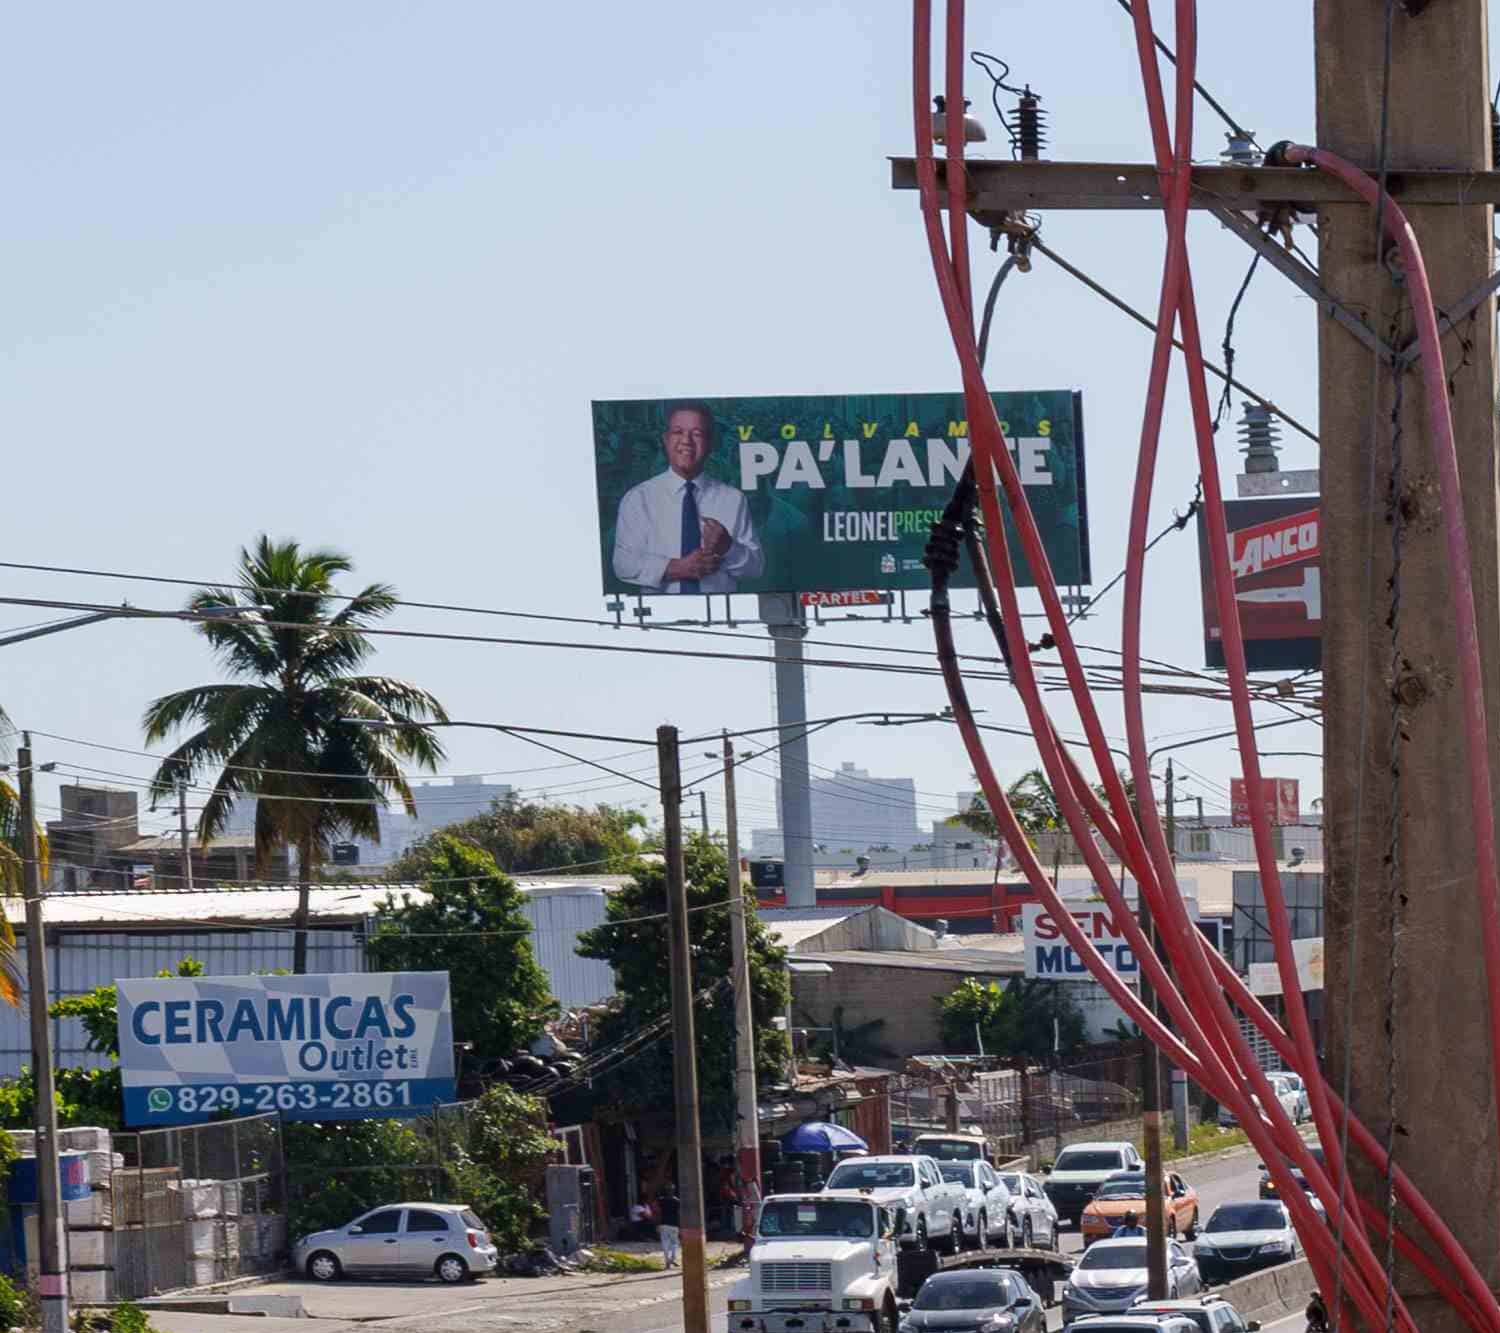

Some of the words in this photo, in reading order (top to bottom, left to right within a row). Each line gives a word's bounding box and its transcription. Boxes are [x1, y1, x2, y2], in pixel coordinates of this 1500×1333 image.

[823, 511, 898, 542] LEONEL
[807, 588, 868, 606] CARTEL
[131, 994, 417, 1046] CERAMICAS
[298, 1039, 410, 1073] Outlet
[177, 1081, 412, 1113] 829-263-2861
